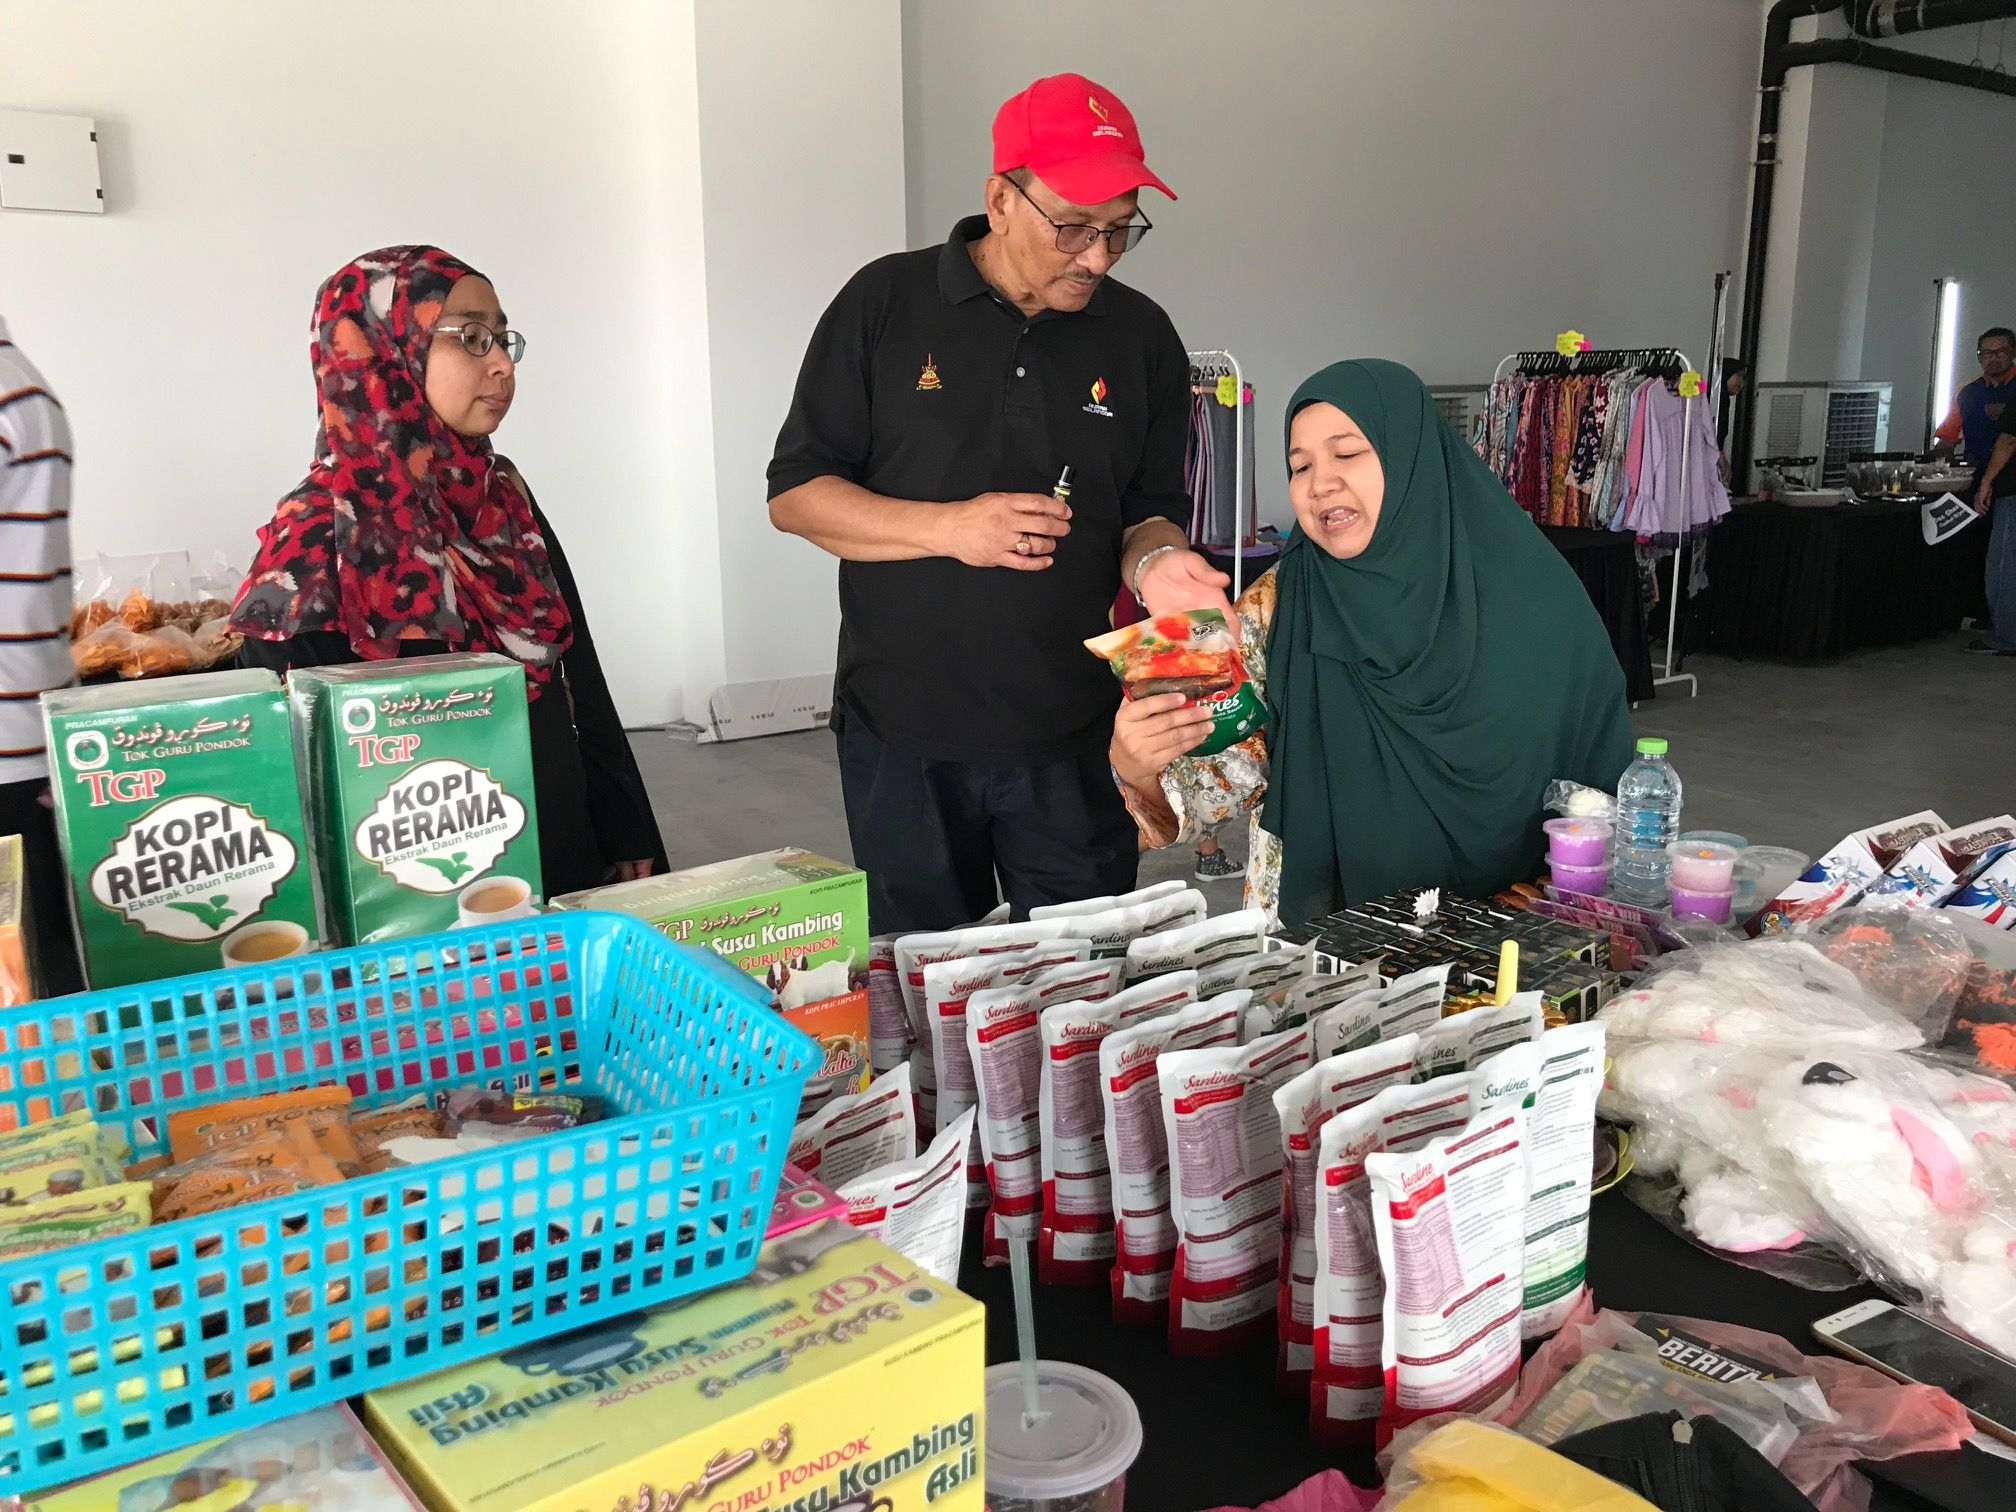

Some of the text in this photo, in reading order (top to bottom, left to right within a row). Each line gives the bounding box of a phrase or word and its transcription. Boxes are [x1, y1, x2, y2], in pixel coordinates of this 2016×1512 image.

[64, 715, 138, 730] PRACAMPURAN
[411, 713, 444, 725] GURU
[446, 708, 493, 721] PONDOK
[121, 737, 252, 762] TOK GURU PONDOK
[348, 733, 421, 768] TGP
[77, 768, 167, 807] TGP
[393, 769, 474, 815] KOPI
[134, 805, 233, 857] KOPI
[368, 788, 507, 858] RERAMA
[384, 822, 508, 866] Ekstrak Daun Rerama
[106, 825, 274, 905] RERAMA
[129, 861, 276, 912] Ekstrak Daun Rerama
[711, 910, 843, 956] Susu Kambing
[738, 936, 841, 974] GURU PONDOK
[949, 975, 993, 997] Sardines
[1137, 955, 1186, 973] Sardines
[985, 999, 1032, 1021] Sardines
[1117, 1042, 1161, 1069] Sardines
[1482, 1077, 1530, 1100] Sardines
[809, 1262, 920, 1317] TGP
[699, 1335, 767, 1370] GURU
[1658, 1338, 1763, 1383] BERITA
[407, 1382, 491, 1428] Asli
[429, 1336, 709, 1447] Susu Kambing
[597, 1363, 699, 1407] PONDOK
[777, 1434, 873, 1488] PONDOK
[838, 1409, 976, 1502] Kambing
[924, 1447, 979, 1505] Asli
